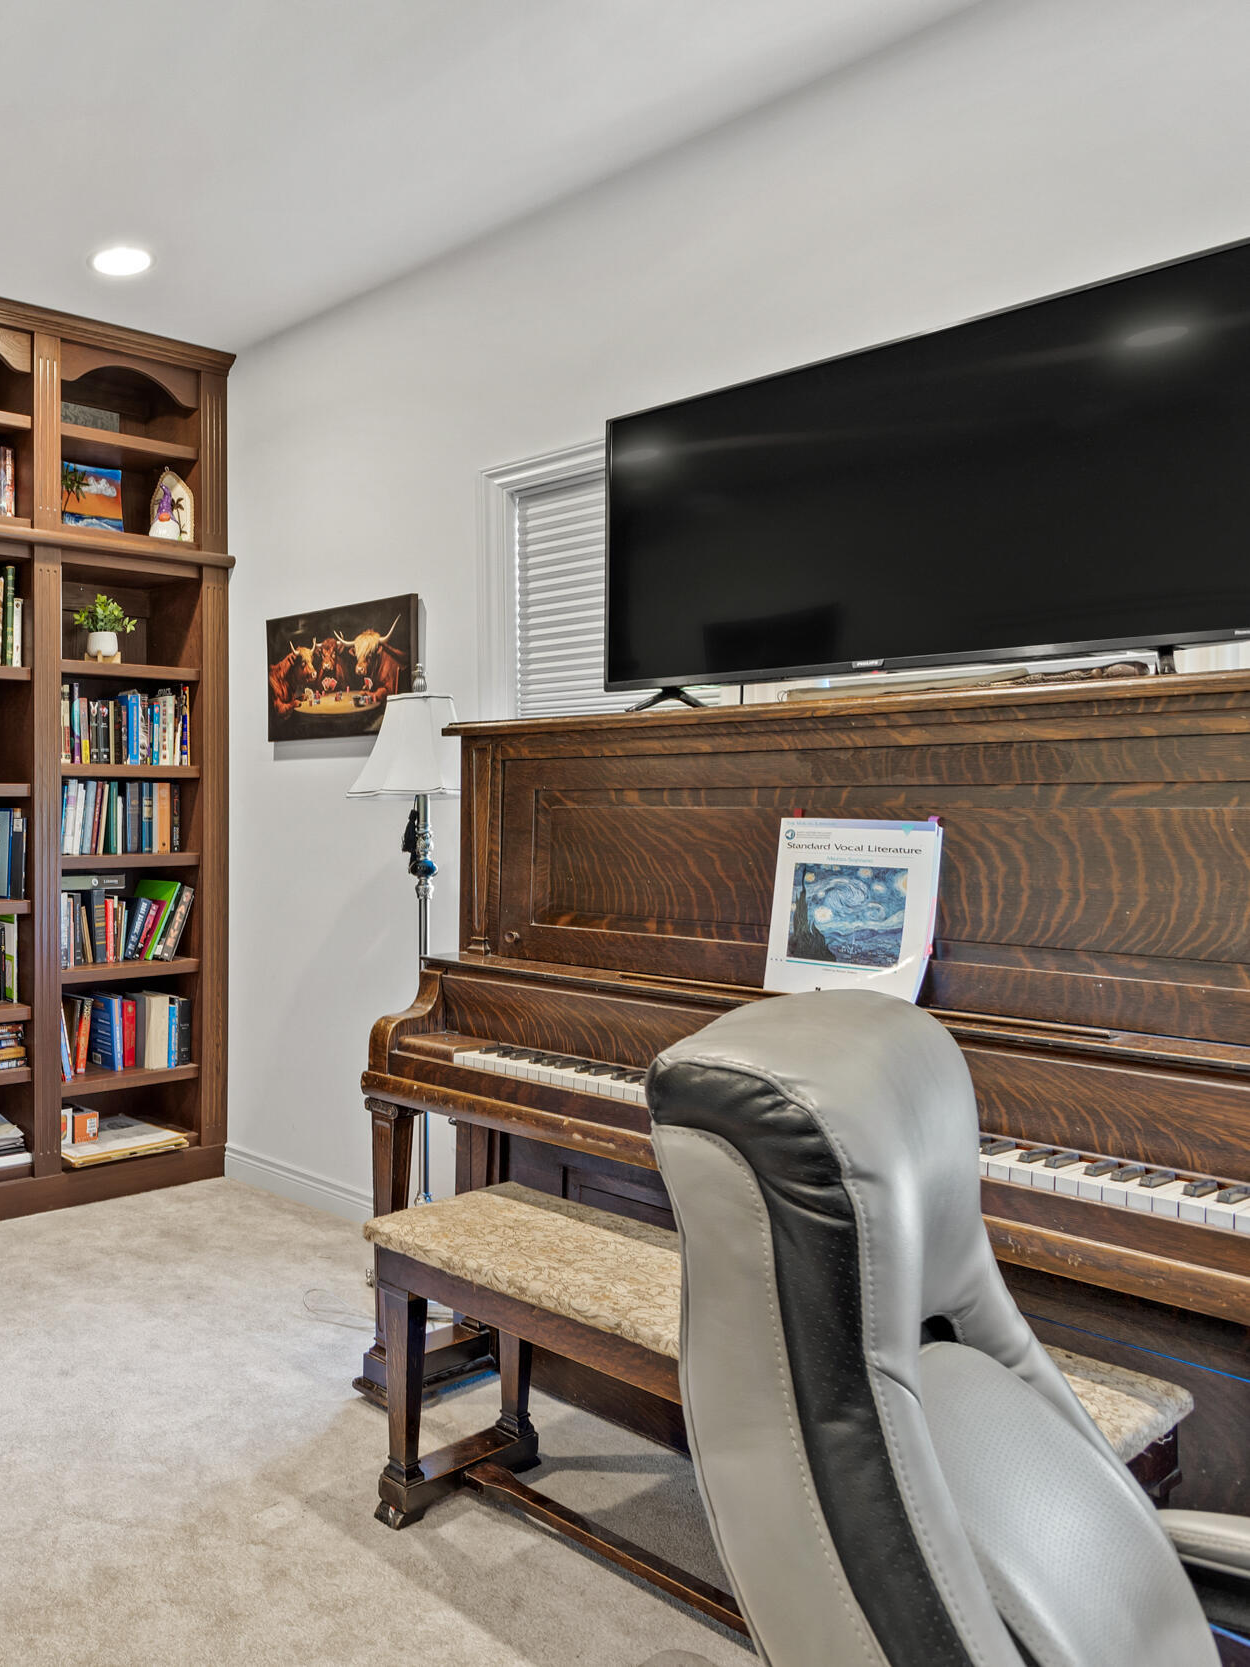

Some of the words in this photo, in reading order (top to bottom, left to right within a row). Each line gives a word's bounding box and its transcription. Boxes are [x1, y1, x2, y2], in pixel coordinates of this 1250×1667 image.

[787, 842, 831, 851] Standard
[835, 844, 864, 852] Vocal
[868, 846, 923, 855] Literature
